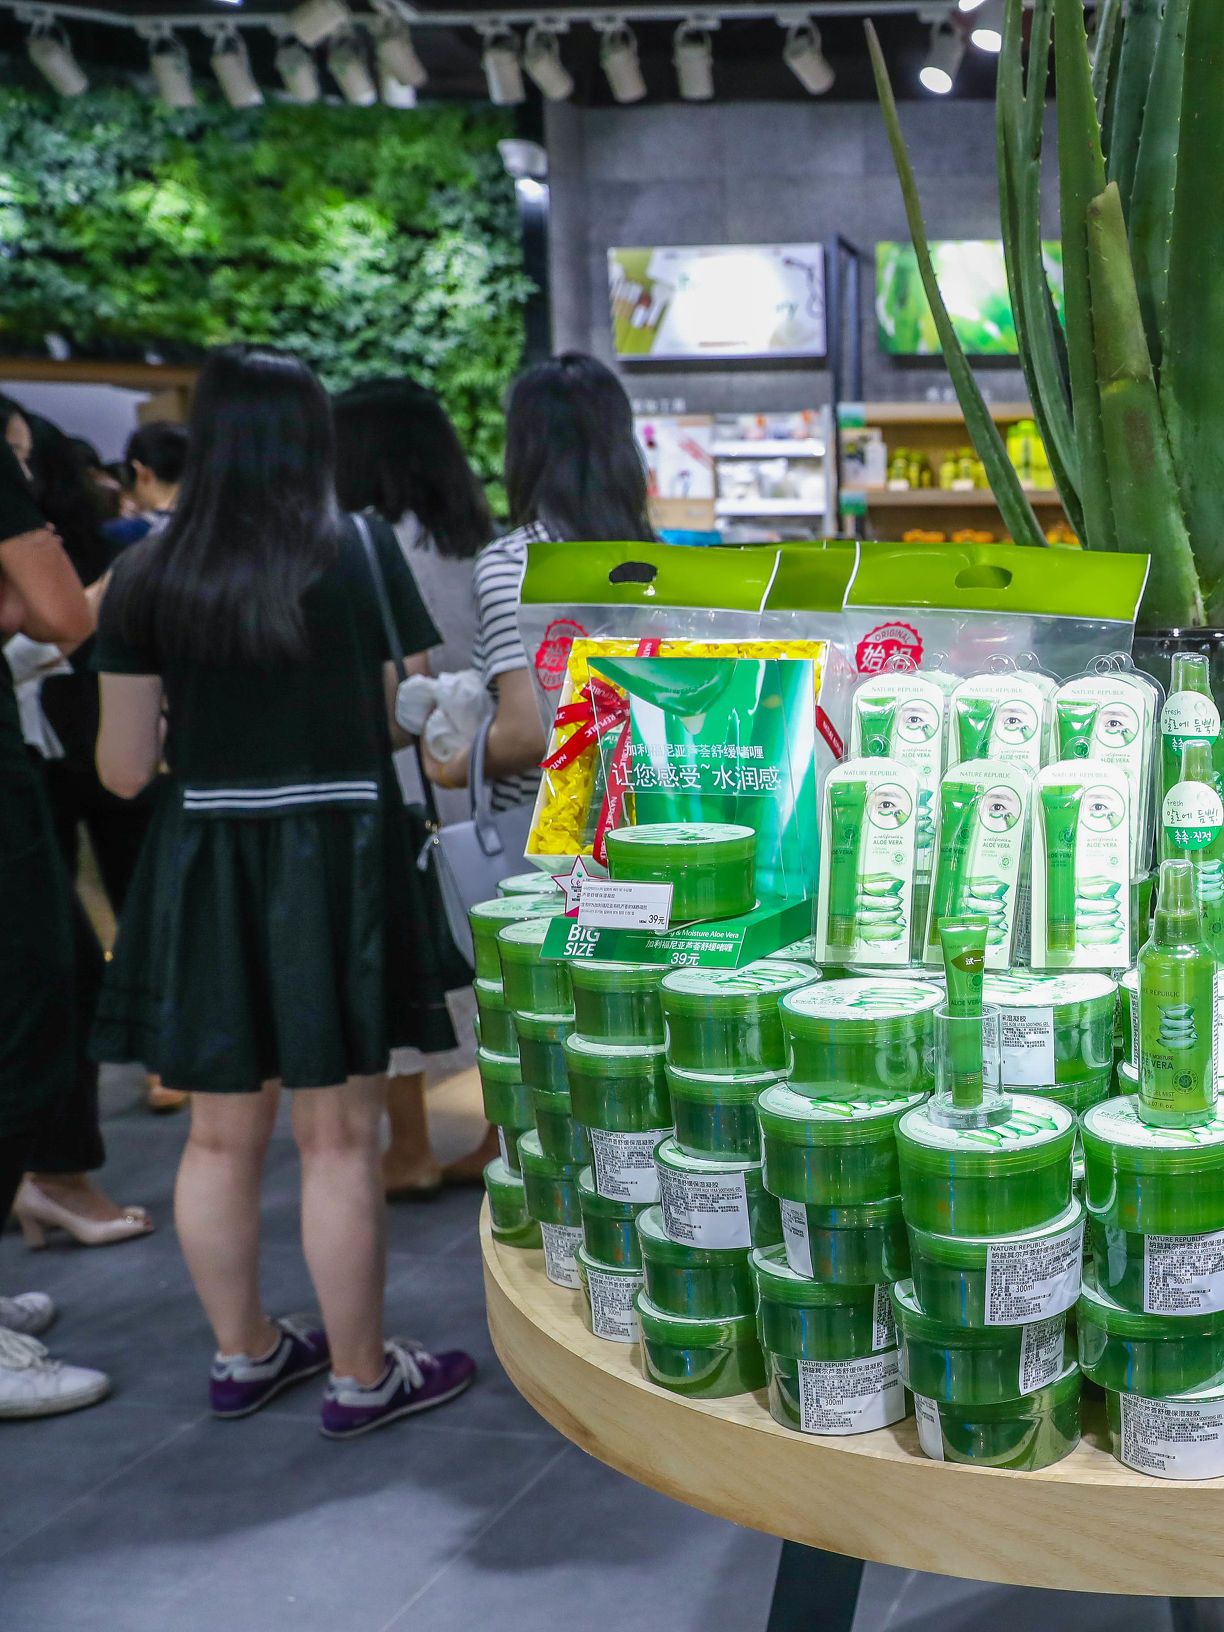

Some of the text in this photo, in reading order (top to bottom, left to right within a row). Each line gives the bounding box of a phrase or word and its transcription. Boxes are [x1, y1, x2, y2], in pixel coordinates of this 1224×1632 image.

[874, 629, 911, 643] ORIGINAL
[1165, 707, 1181, 715] fresh
[1167, 799, 1183, 807] fresh
[648, 914, 664, 925] 39元
[568, 924, 600, 942] BIG
[564, 942, 596, 957] SIZE
[670, 952, 700, 966] 39元
[1152, 1061, 1174, 1070] VERA
[1148, 1235, 1174, 1243] NATURE
[1019, 1240, 1047, 1250] REPUBLIC
[1141, 1398, 1168, 1409] REPUBLIC
